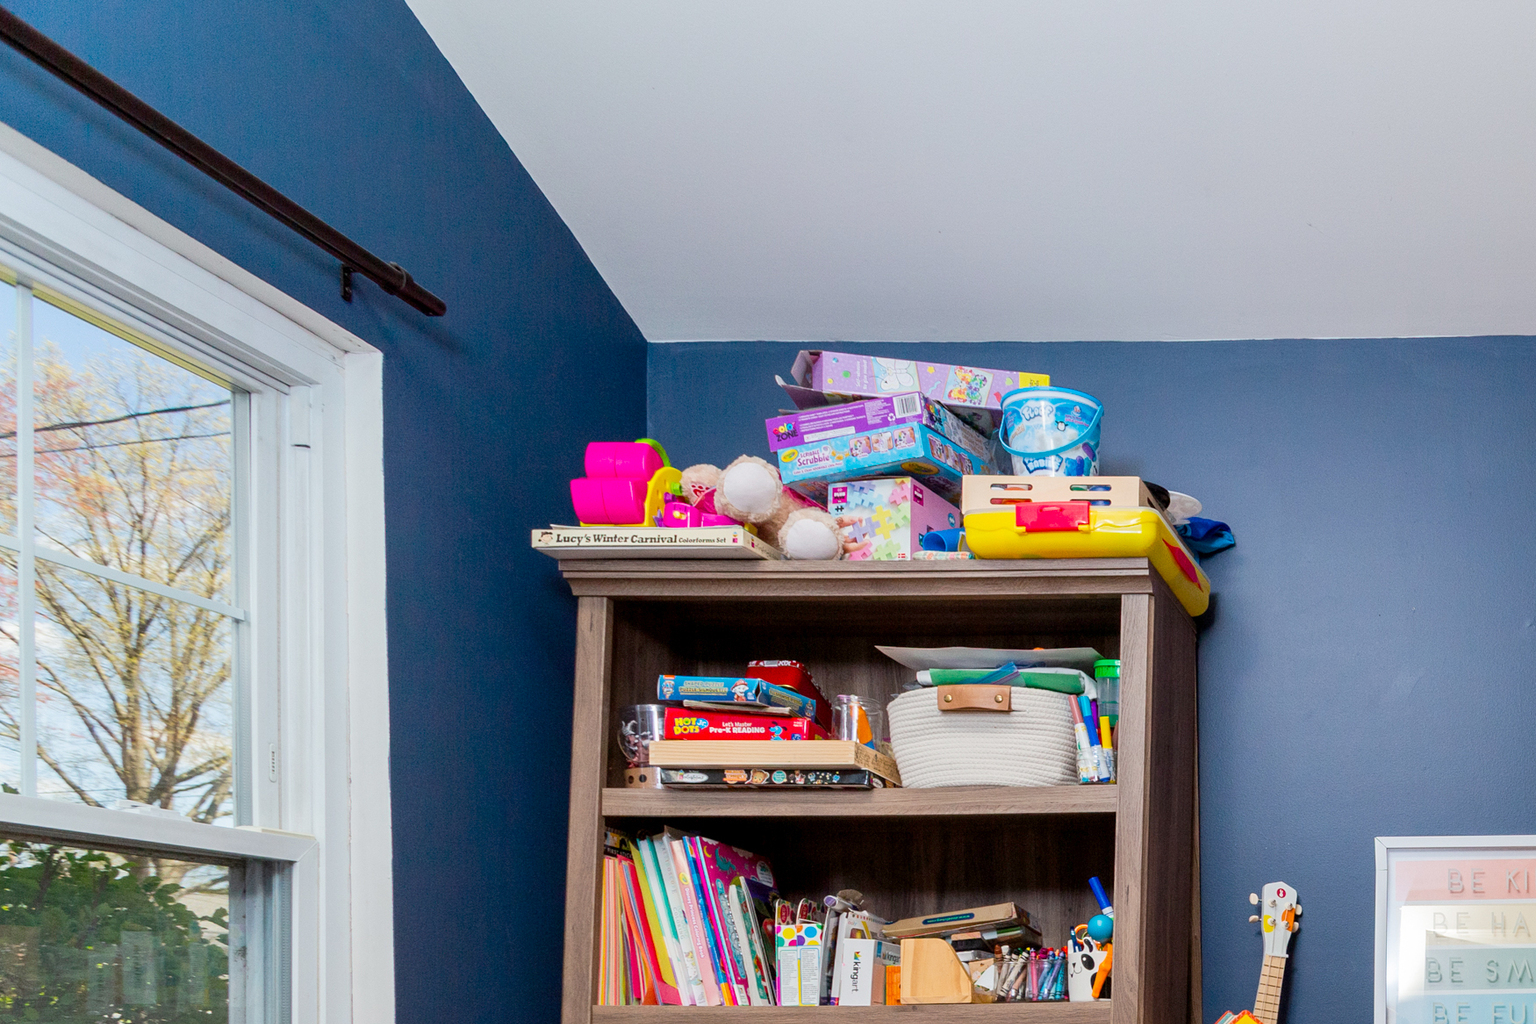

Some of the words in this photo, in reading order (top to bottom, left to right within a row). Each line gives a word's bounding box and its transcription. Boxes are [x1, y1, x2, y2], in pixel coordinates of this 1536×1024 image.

[776, 430, 798, 442] ZONE
[556, 533, 591, 546] Lucy's
[593, 534, 629, 543] Winter
[631, 534, 677, 543] Carnival
[674, 718, 696, 727] HOT
[674, 726, 700, 735] DOTS
[732, 726, 765, 734] READING
[1447, 868, 1486, 894] BE
[1432, 912, 1470, 938] BE
[850, 961, 862, 992] kingart
[1426, 957, 1464, 983] BE
